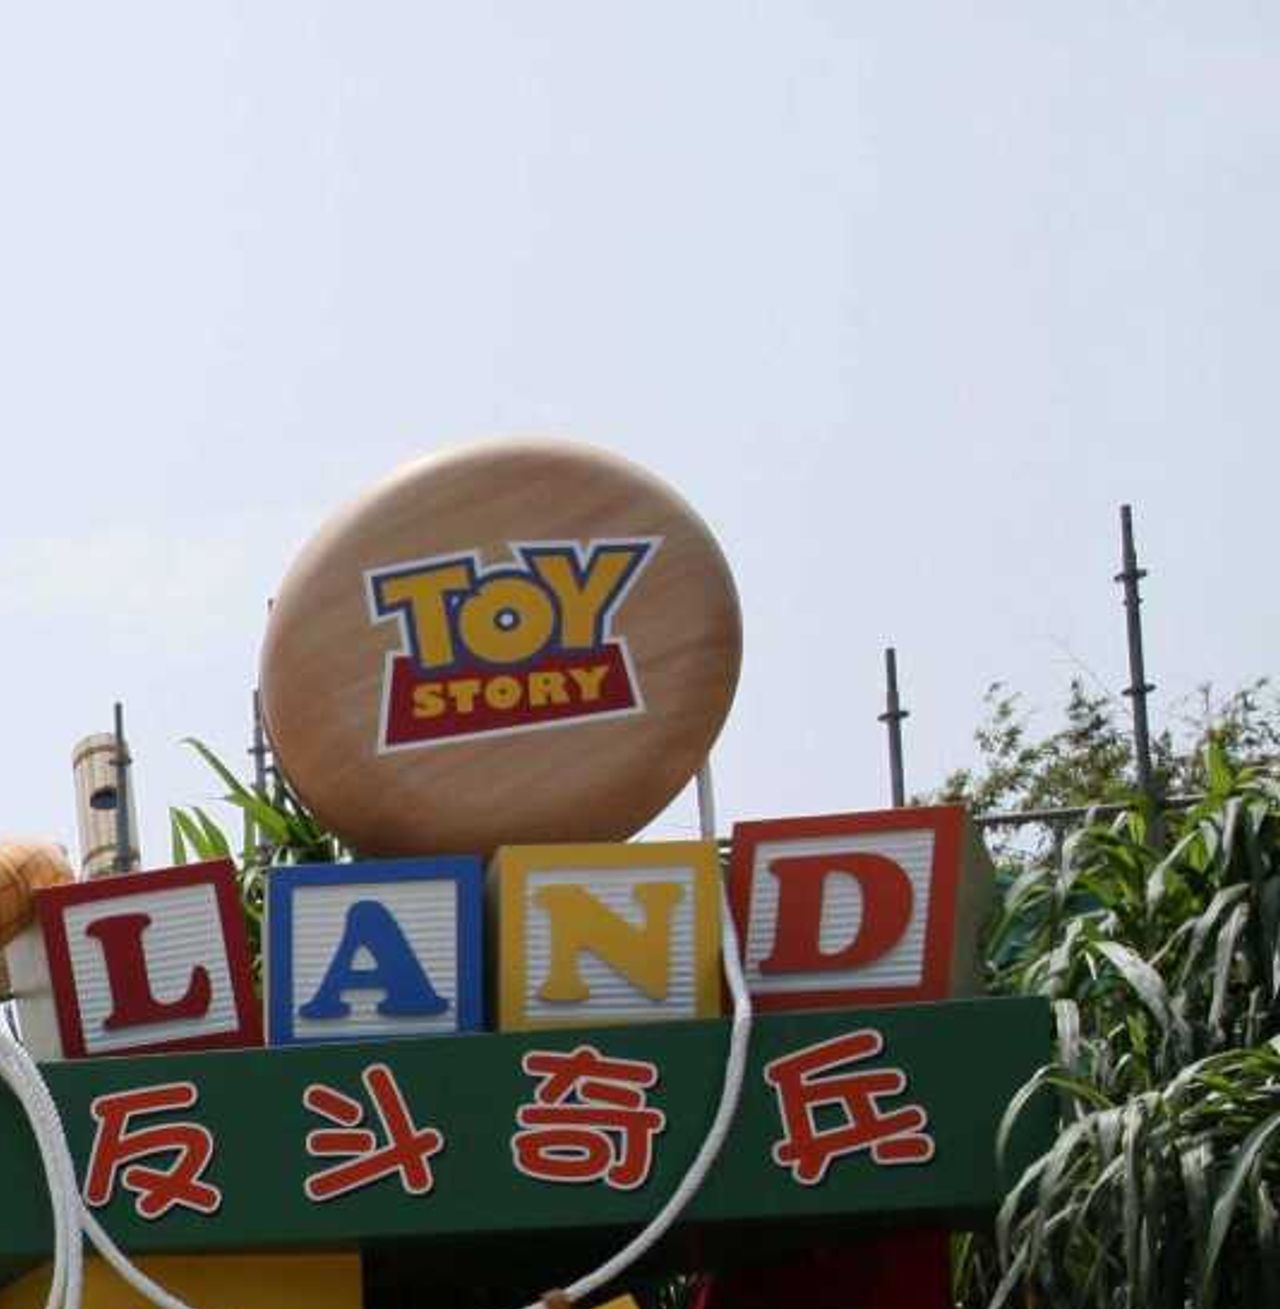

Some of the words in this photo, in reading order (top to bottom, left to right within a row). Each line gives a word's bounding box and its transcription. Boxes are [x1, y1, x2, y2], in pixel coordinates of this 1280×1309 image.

[372, 543, 651, 673] TOY
[411, 665, 610, 718] STORY
[85, 851, 914, 1030] LAND
[83, 1029, 934, 1219] 反斗奇兵
